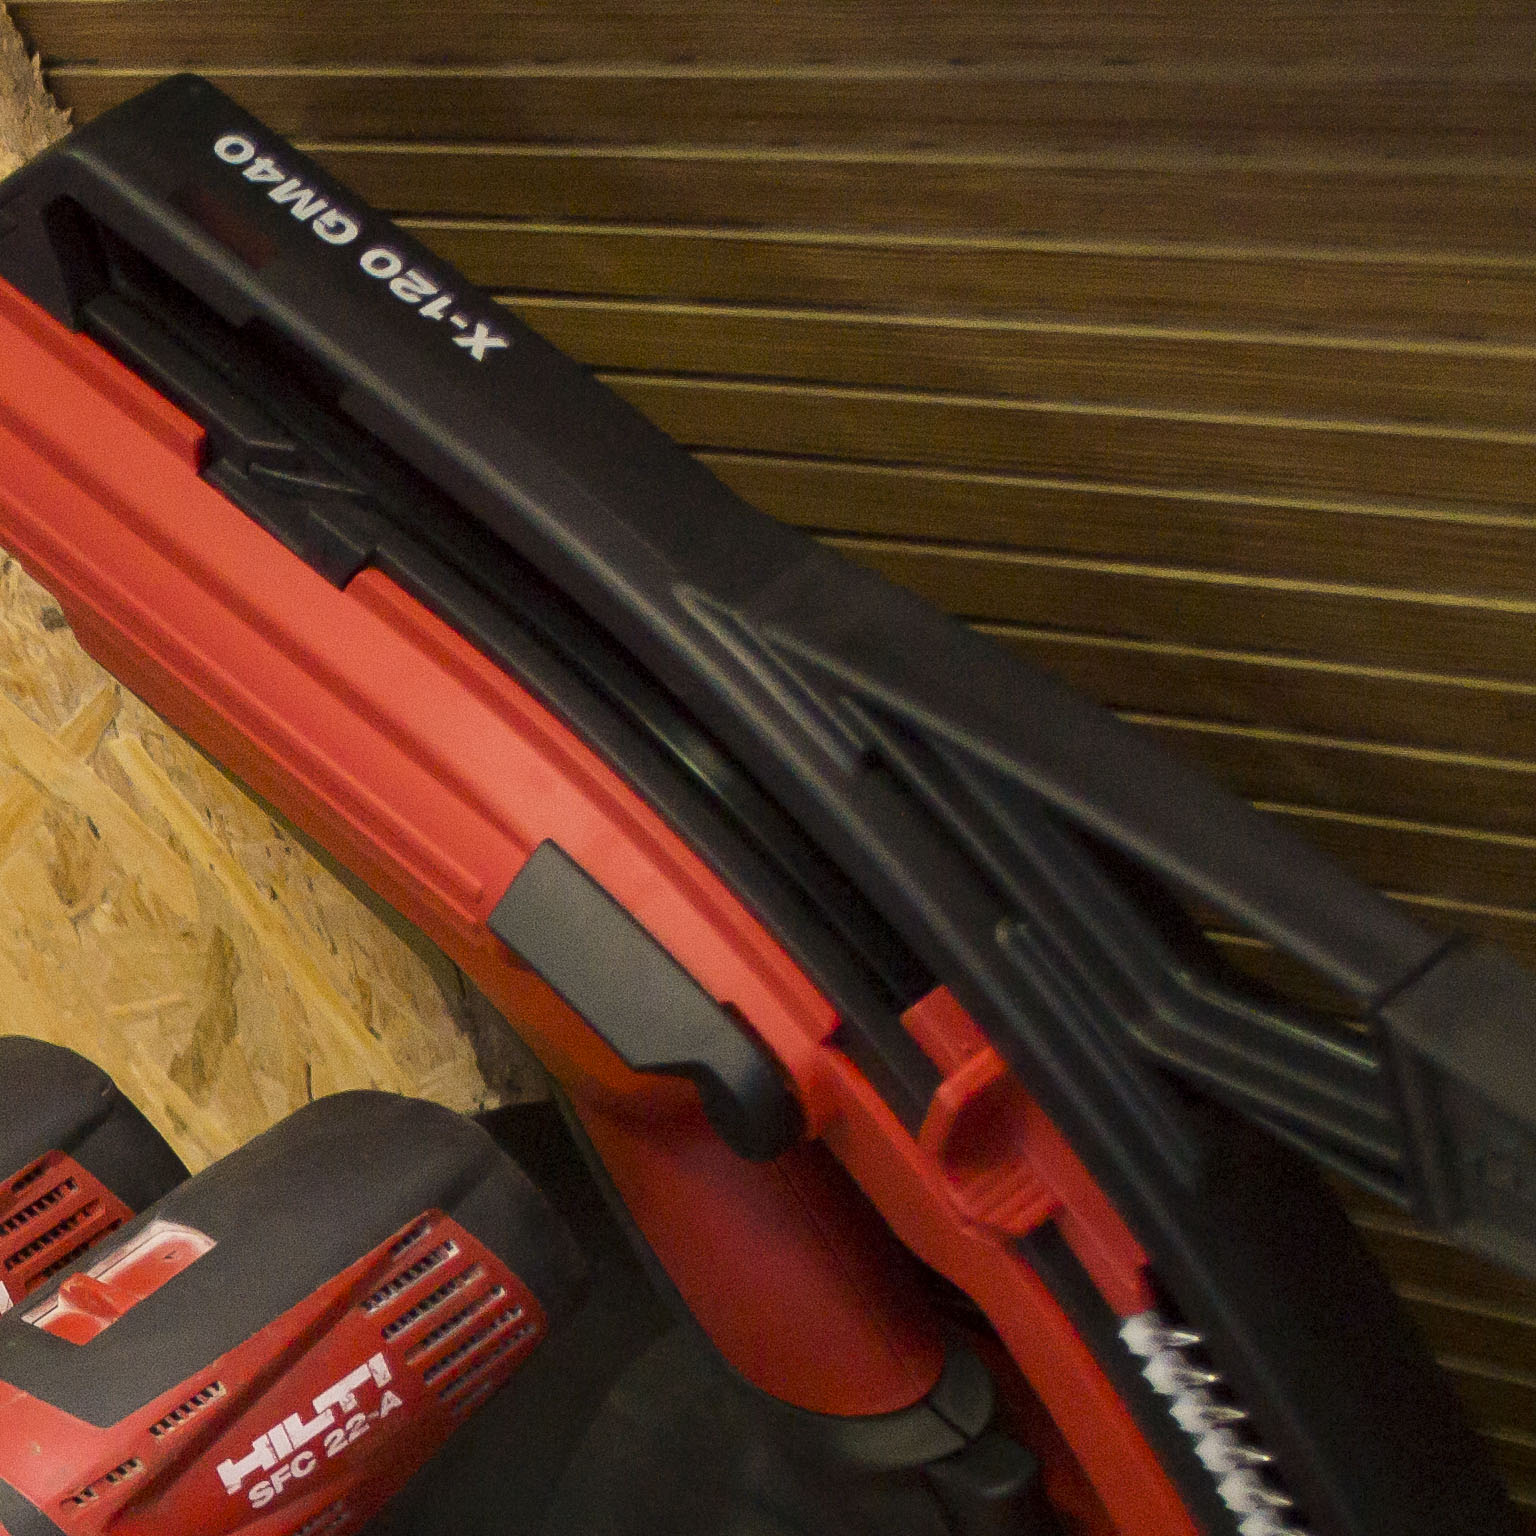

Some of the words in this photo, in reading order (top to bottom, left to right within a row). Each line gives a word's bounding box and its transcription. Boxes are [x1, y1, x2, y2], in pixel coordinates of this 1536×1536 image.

[214, 135, 358, 245] GM40
[360, 248, 509, 361] X-120
[215, 1352, 393, 1496] HILTI
[248, 1450, 317, 1509] SFC
[323, 1389, 403, 1458] 22-A
